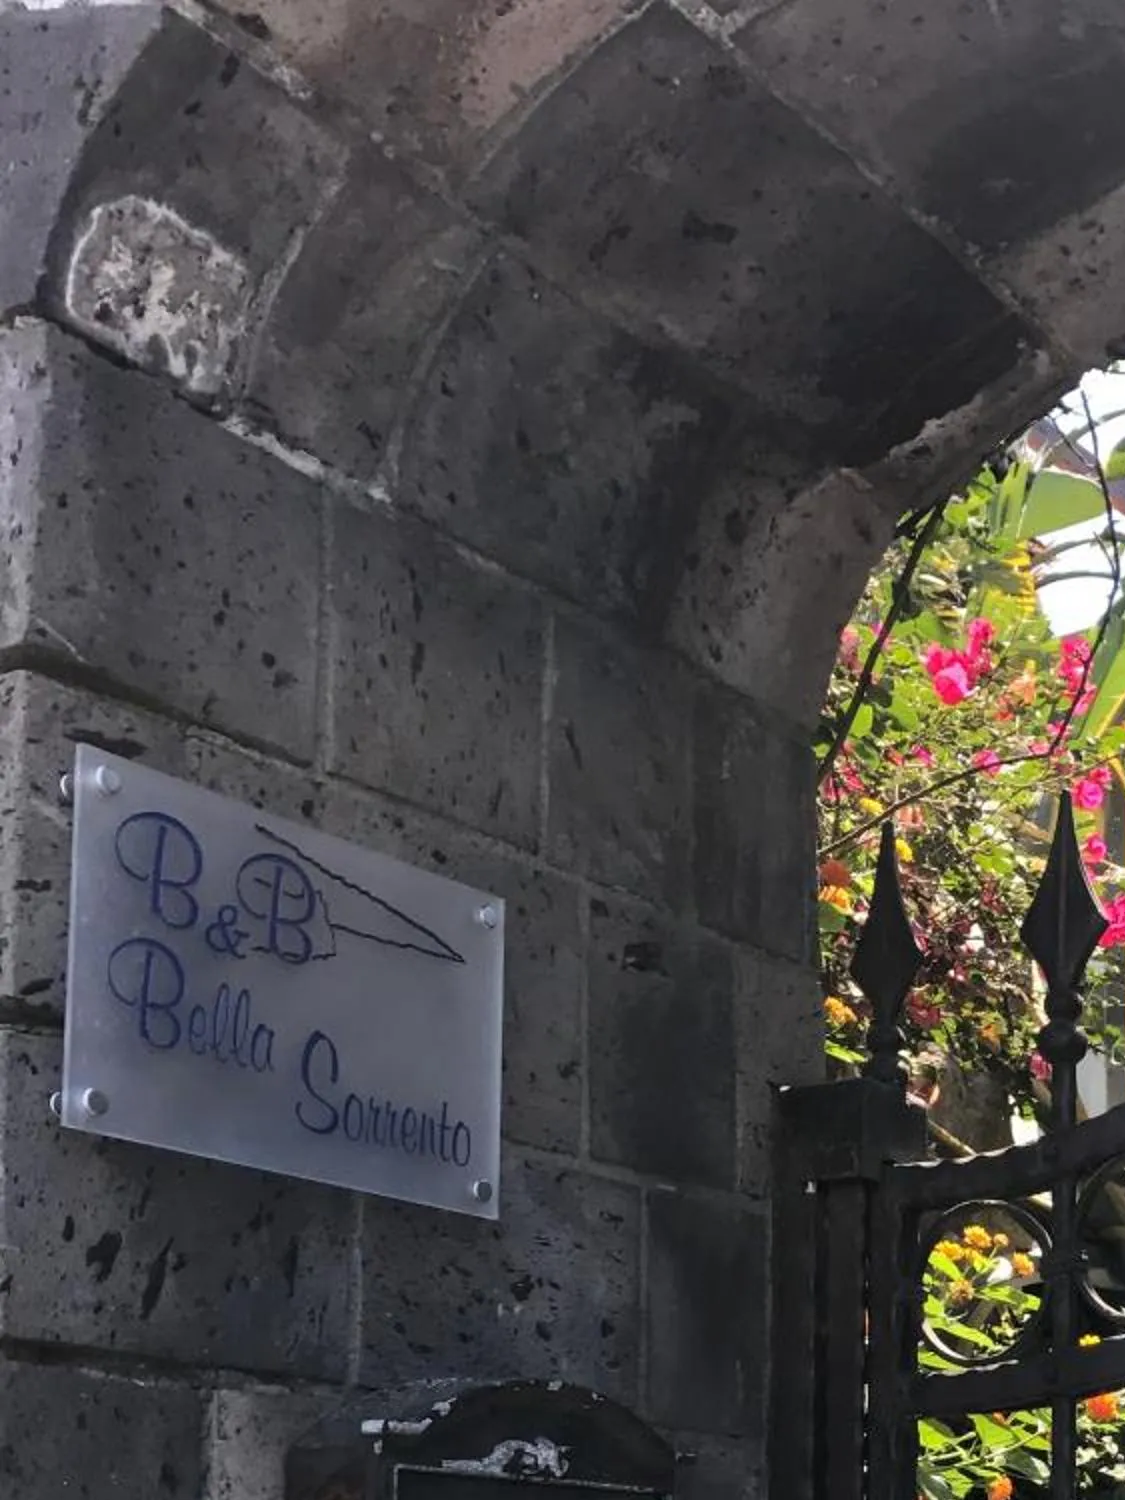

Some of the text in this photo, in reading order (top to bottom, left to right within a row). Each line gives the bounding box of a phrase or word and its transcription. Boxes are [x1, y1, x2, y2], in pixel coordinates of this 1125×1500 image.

[114, 811, 315, 964] B&B
[107, 937, 471, 1167] Bella Sorrento
